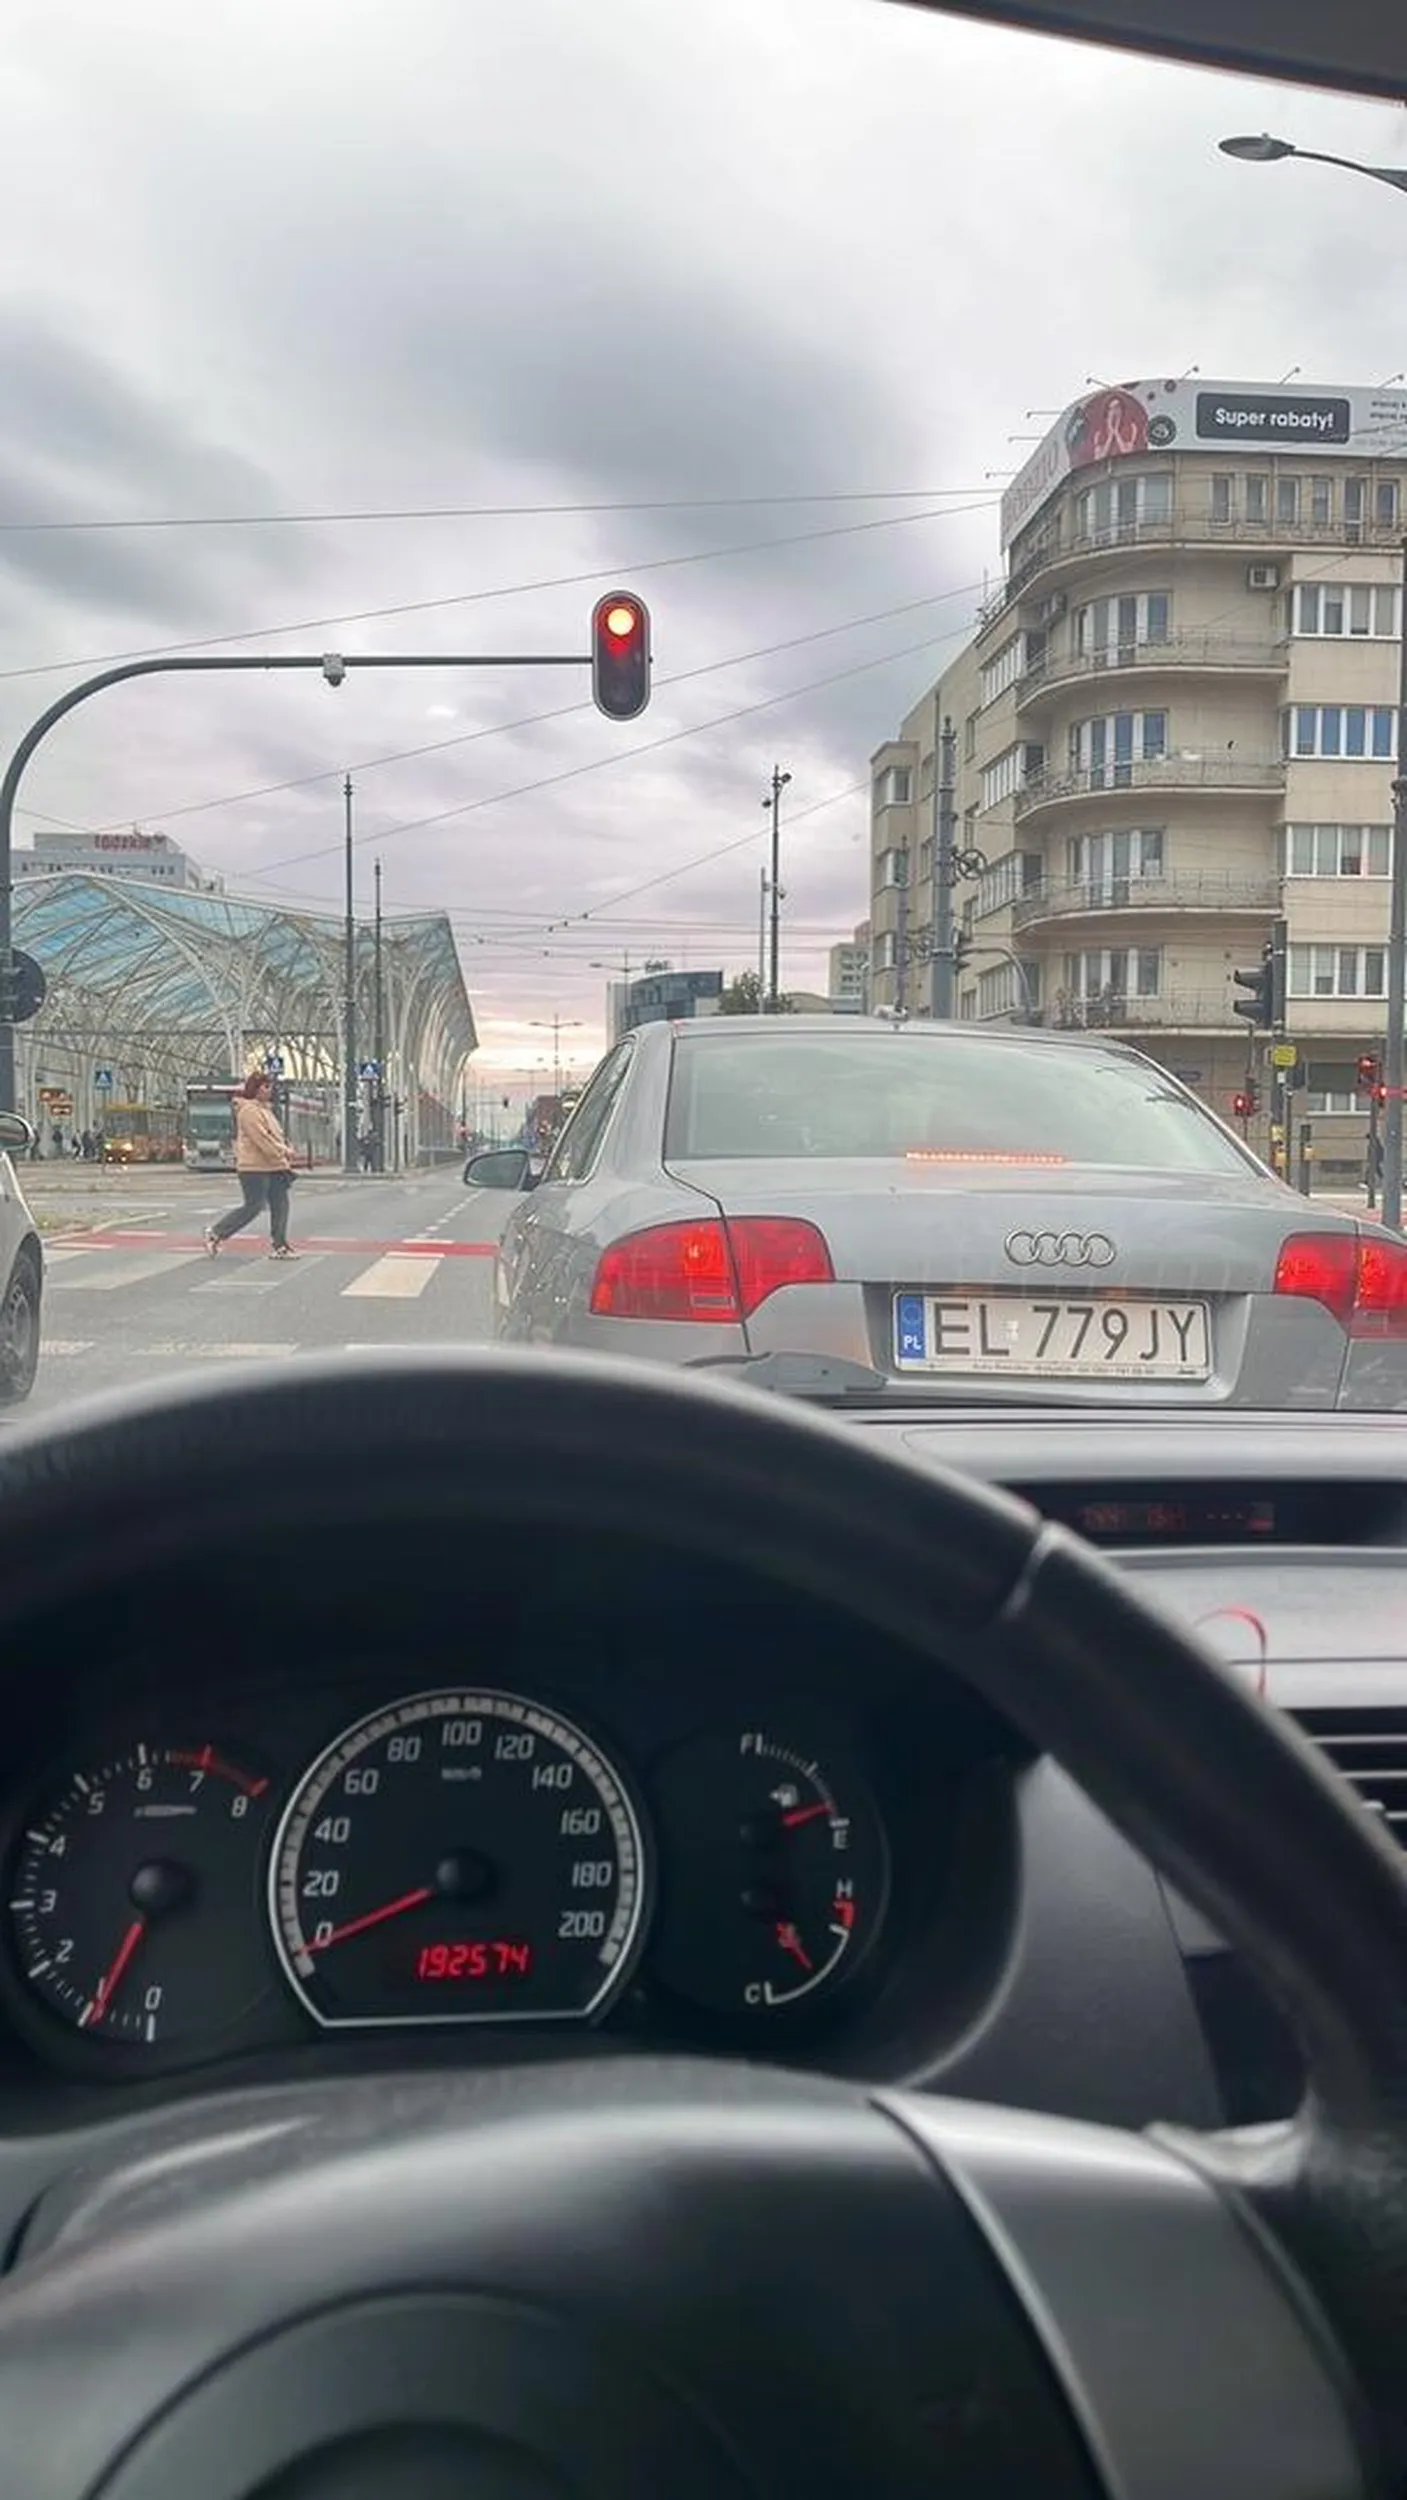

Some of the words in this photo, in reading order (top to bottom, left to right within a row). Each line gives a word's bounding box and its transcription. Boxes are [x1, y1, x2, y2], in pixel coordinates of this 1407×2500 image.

[1215, 407, 1266, 427] Super
[1270, 411, 1334, 432] rabaty!
[903, 1335, 922, 1350] PL
[933, 1302, 1010, 1357] EL
[1033, 1304, 1196, 1363] 779JY
[441, 1720, 482, 1746] 100
[387, 1736, 421, 1762] 80
[494, 1734, 535, 1760] 120
[136, 1767, 152, 1790] 6
[189, 1770, 205, 1793] 7
[344, 1768, 379, 1794] 60
[532, 1764, 573, 1790] 140
[87, 1792, 105, 1815] 5
[231, 1795, 249, 1818] 8
[314, 1817, 351, 1843] 40
[560, 1809, 601, 1835] 160
[48, 1835, 67, 1856] 4
[832, 1829, 848, 1849] E
[303, 1870, 339, 1897] 20
[571, 1861, 612, 1887] 180
[39, 1889, 57, 1913] 3
[836, 1878, 853, 1899] H
[314, 1921, 334, 1947] 0
[558, 1911, 605, 1938] 200
[55, 1939, 75, 1963] 2
[418, 1943, 530, 1980] 192574
[145, 1986, 162, 2011] 0
[744, 1983, 761, 2004] C
